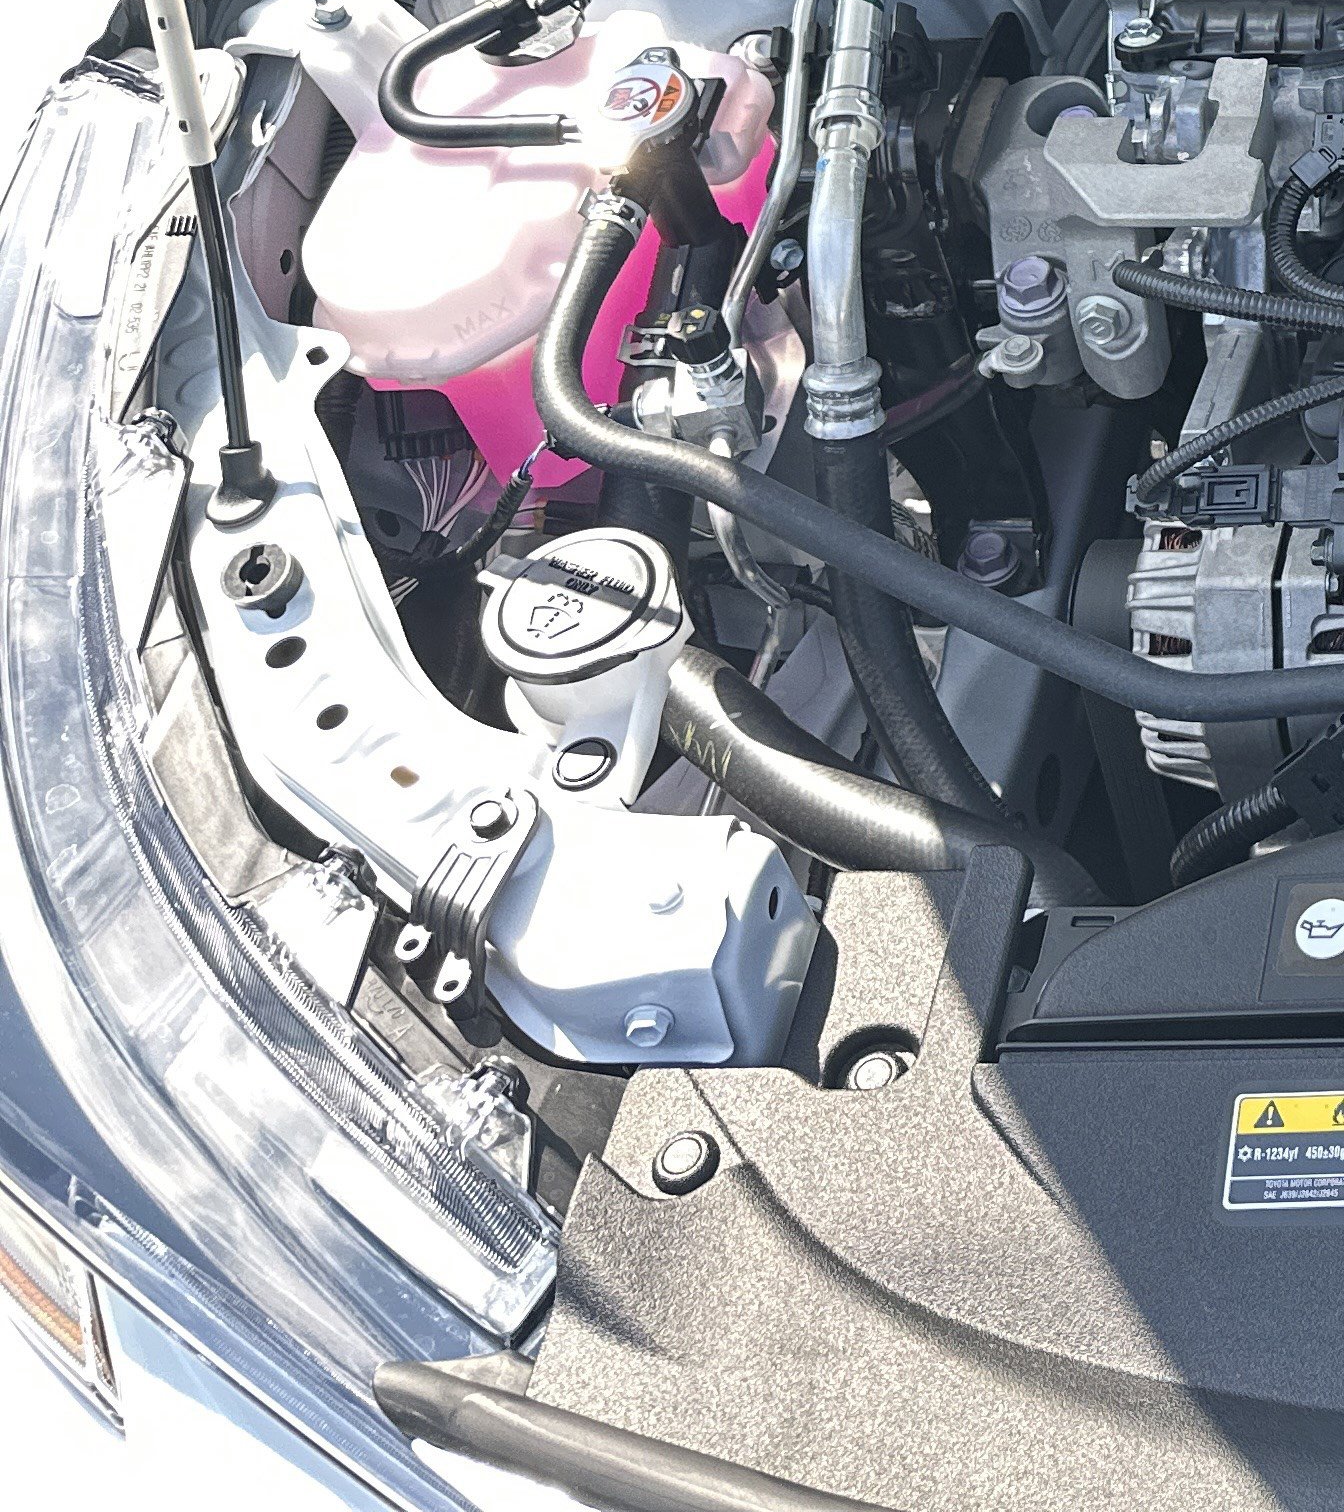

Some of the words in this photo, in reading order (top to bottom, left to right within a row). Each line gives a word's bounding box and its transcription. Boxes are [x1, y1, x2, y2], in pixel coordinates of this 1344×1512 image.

[453, 296, 515, 340] MAX
[549, 555, 599, 581] WASHER
[565, 577, 600, 596] ONLY
[1253, 1146, 1299, 1162] R-1234yf
[1265, 1179, 1289, 1188] TOYOTA
[1290, 1178, 1313, 1187] MOTOR
[1263, 1190, 1277, 1200] SAE
